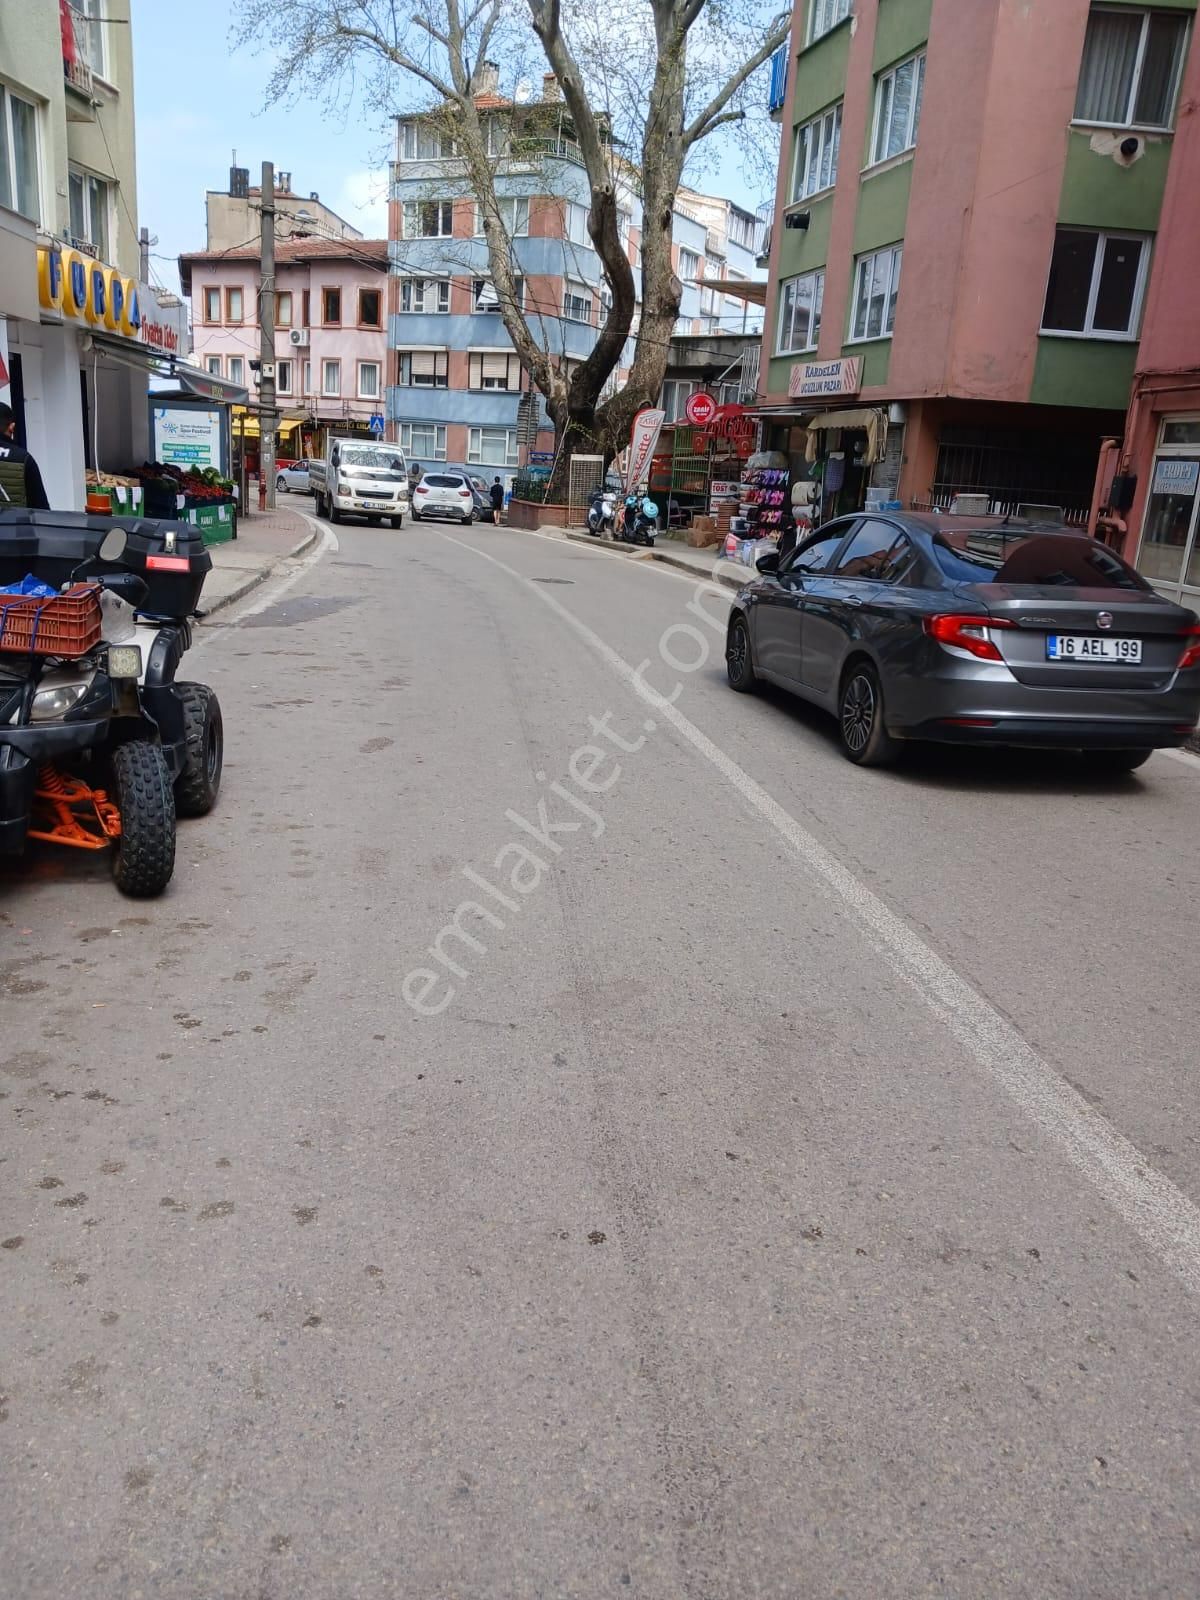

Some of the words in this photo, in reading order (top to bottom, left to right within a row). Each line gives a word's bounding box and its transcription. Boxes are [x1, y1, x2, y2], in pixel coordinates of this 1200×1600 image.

[50, 251, 141, 329] FURPA
[805, 362, 842, 378] KARDELEN
[801, 382, 823, 393] UCUZLUK
[823, 380, 842, 392] PAZARI
[1059, 638, 1074, 654] 16
[1081, 639, 1108, 656] AEL
[1115, 641, 1138, 657] 199
